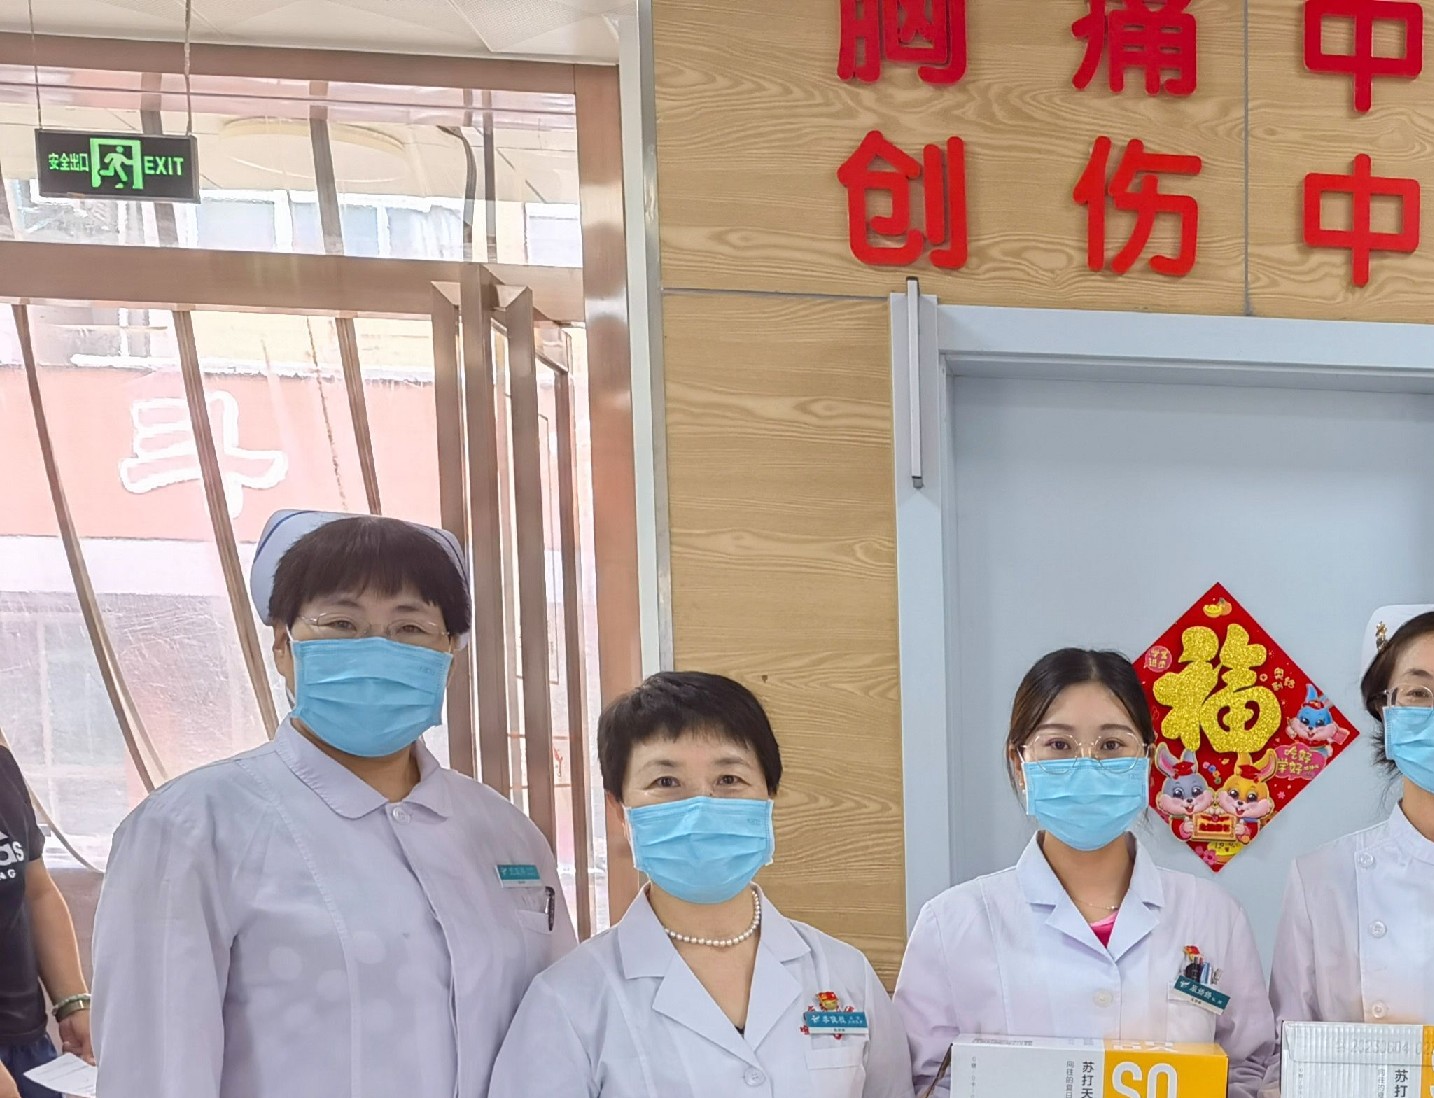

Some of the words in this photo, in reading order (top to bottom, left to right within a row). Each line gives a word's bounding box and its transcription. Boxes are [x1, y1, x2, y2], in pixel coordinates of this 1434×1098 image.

[48, 152, 89, 172] 安全出口
[143, 156, 184, 176] EXIT
[1152, 623, 1282, 753] 福
